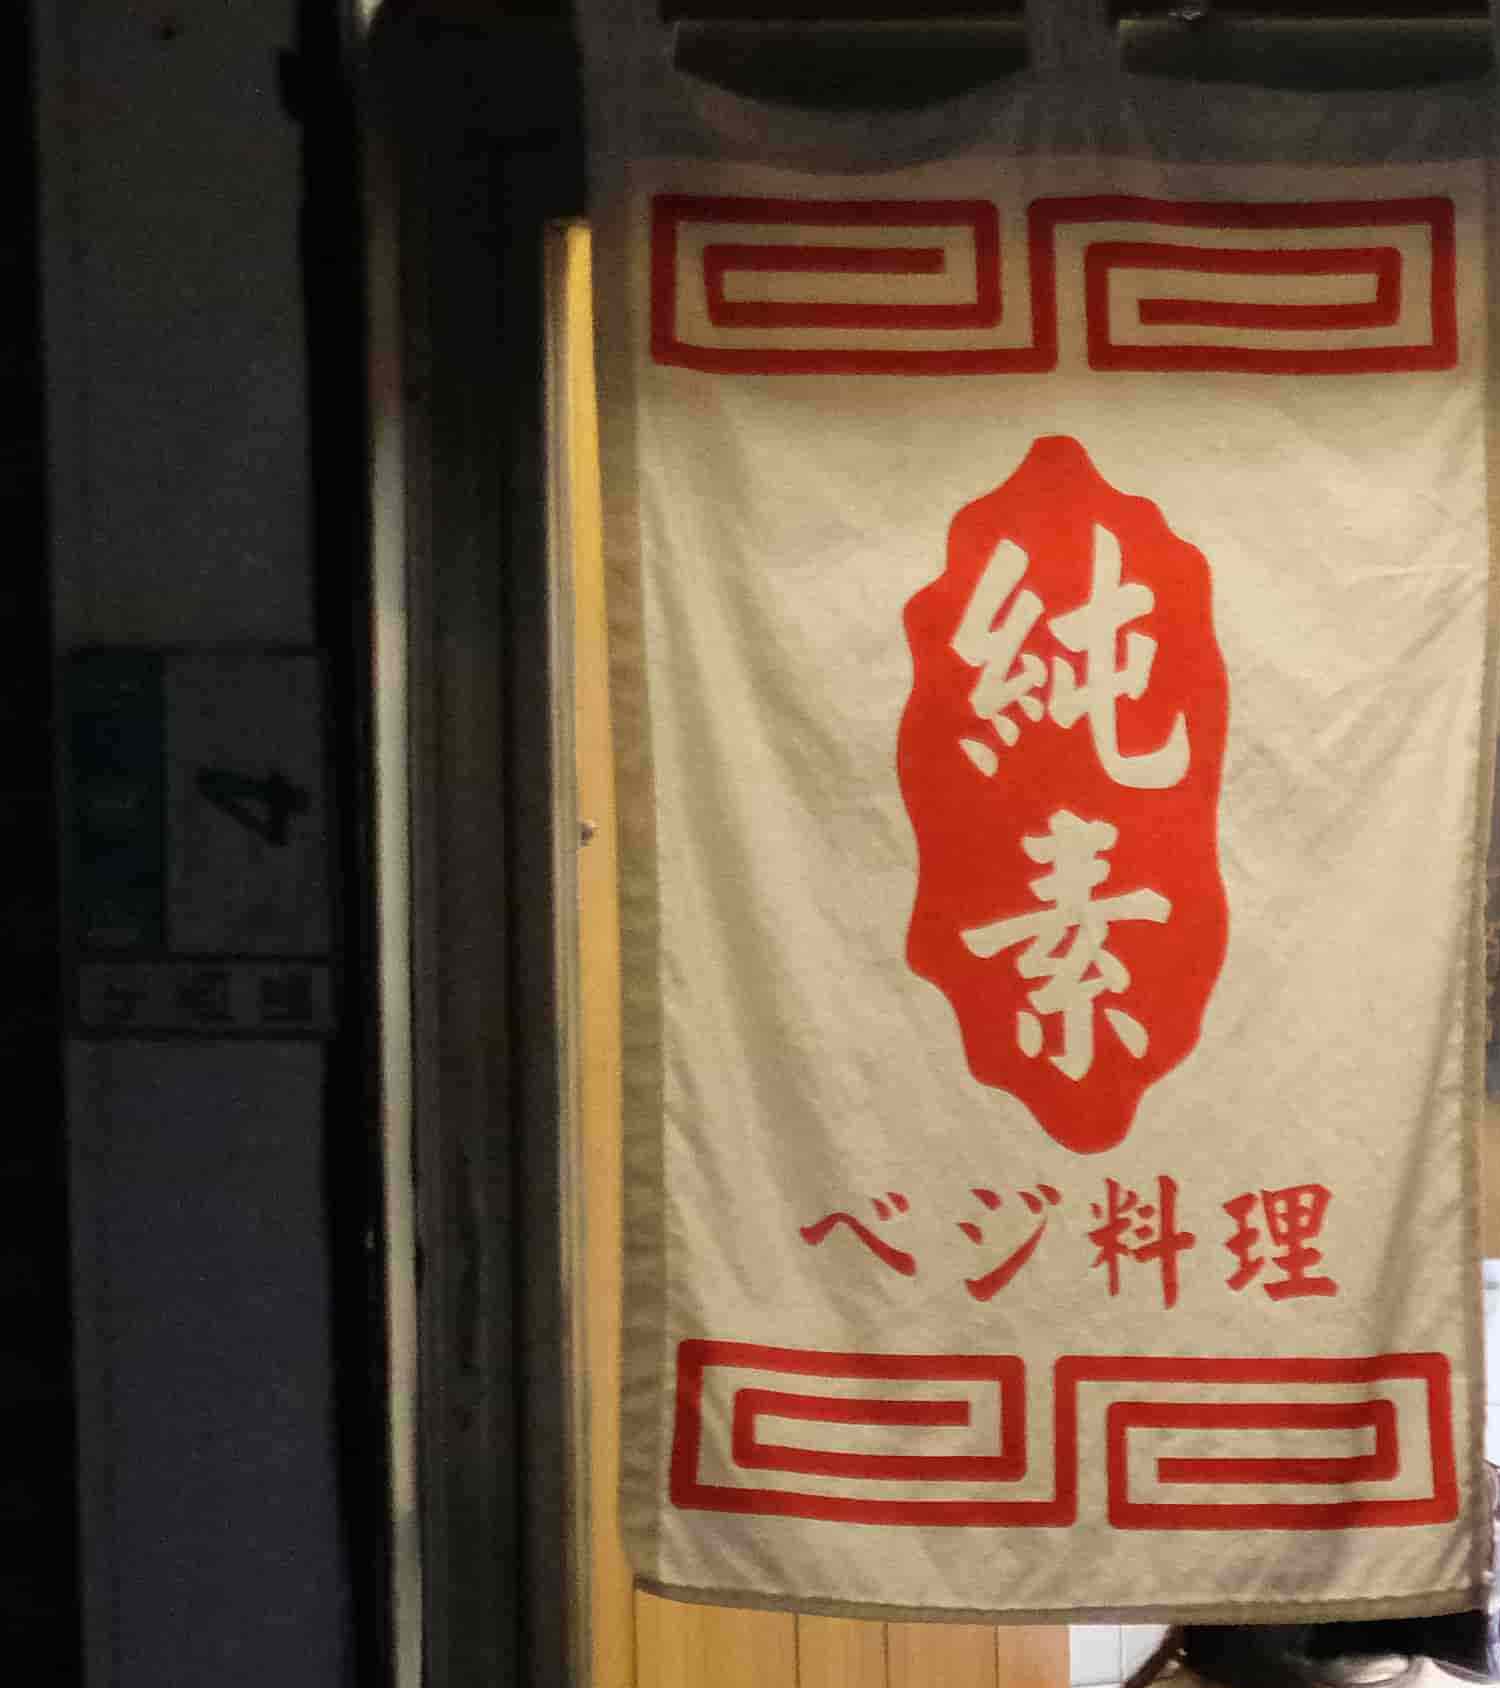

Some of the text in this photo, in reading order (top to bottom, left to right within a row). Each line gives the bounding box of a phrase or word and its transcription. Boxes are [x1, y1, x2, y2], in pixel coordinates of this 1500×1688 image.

[948, 522, 1192, 1082] 純素
[800, 1174, 1339, 1310] ベジ料理
